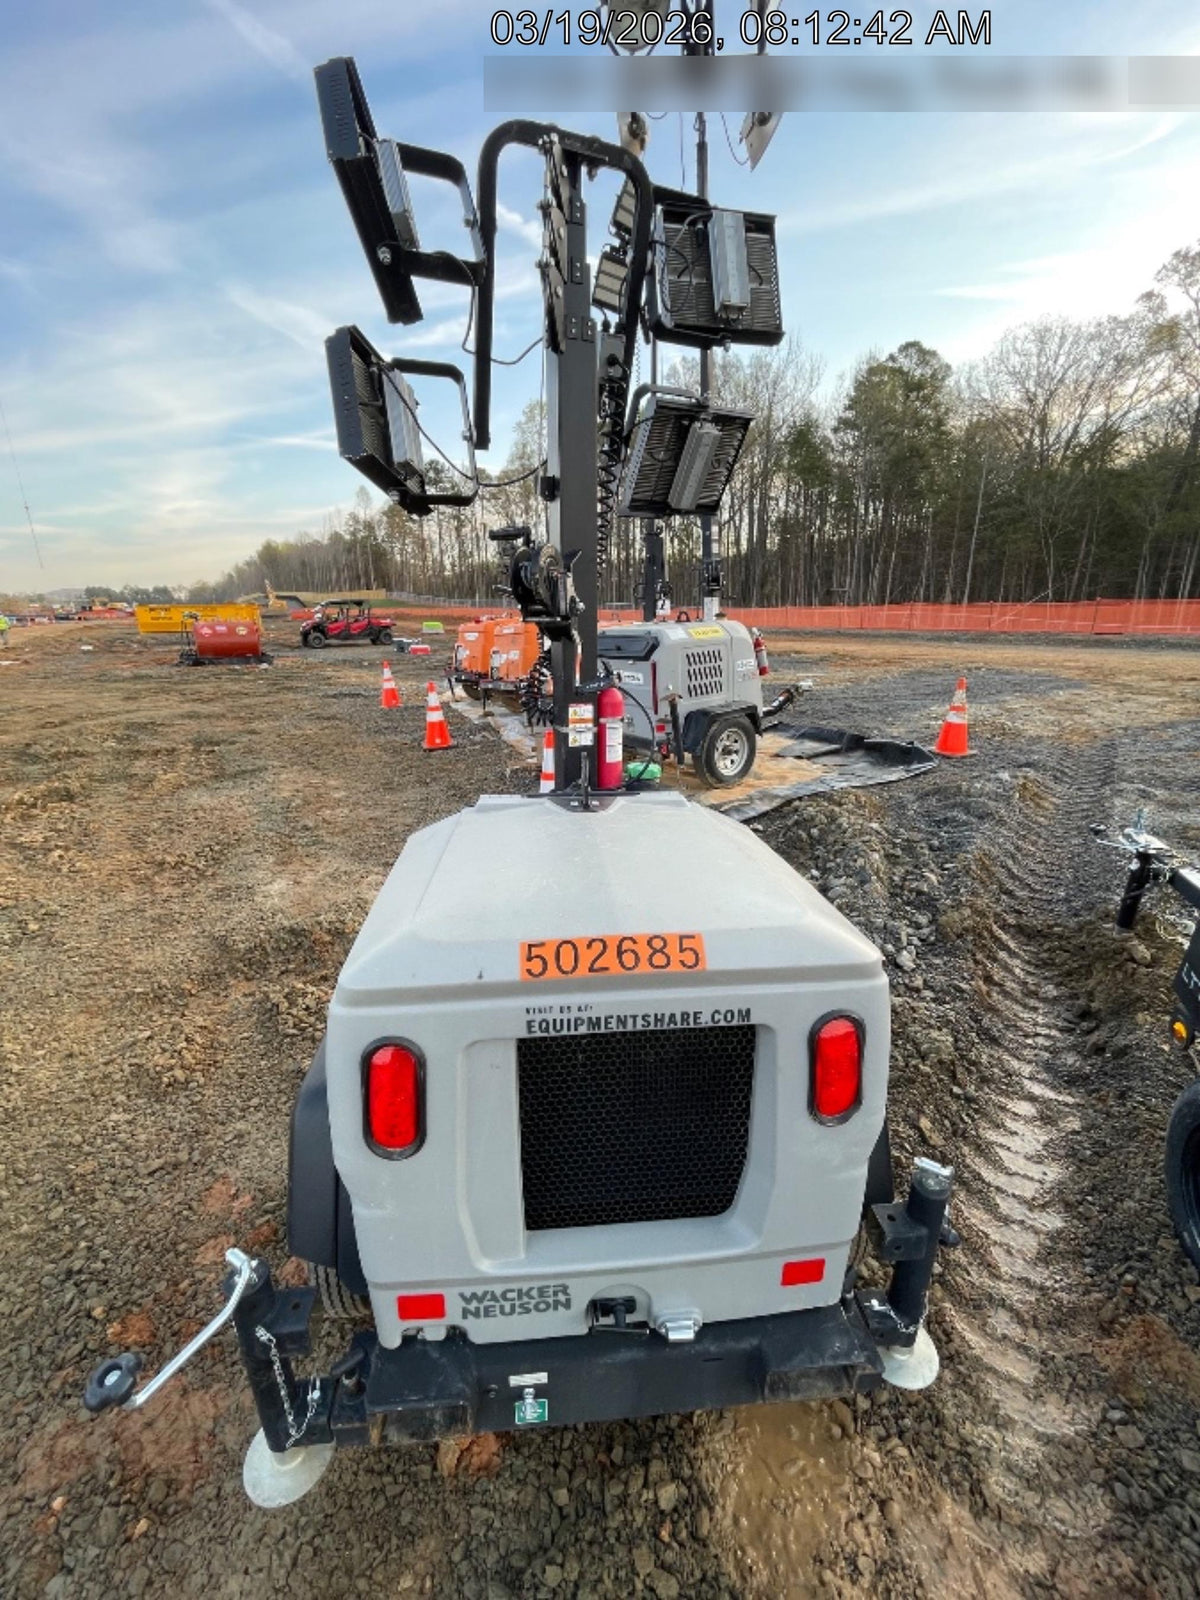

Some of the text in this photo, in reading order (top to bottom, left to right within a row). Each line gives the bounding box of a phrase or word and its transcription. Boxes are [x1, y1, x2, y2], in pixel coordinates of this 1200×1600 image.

[525, 935, 700, 978] 502685
[526, 1008, 751, 1035] EQUIPMENTSHARE.COM
[458, 1283, 571, 1305] WACKER
[461, 1298, 571, 1320] NEUSON
